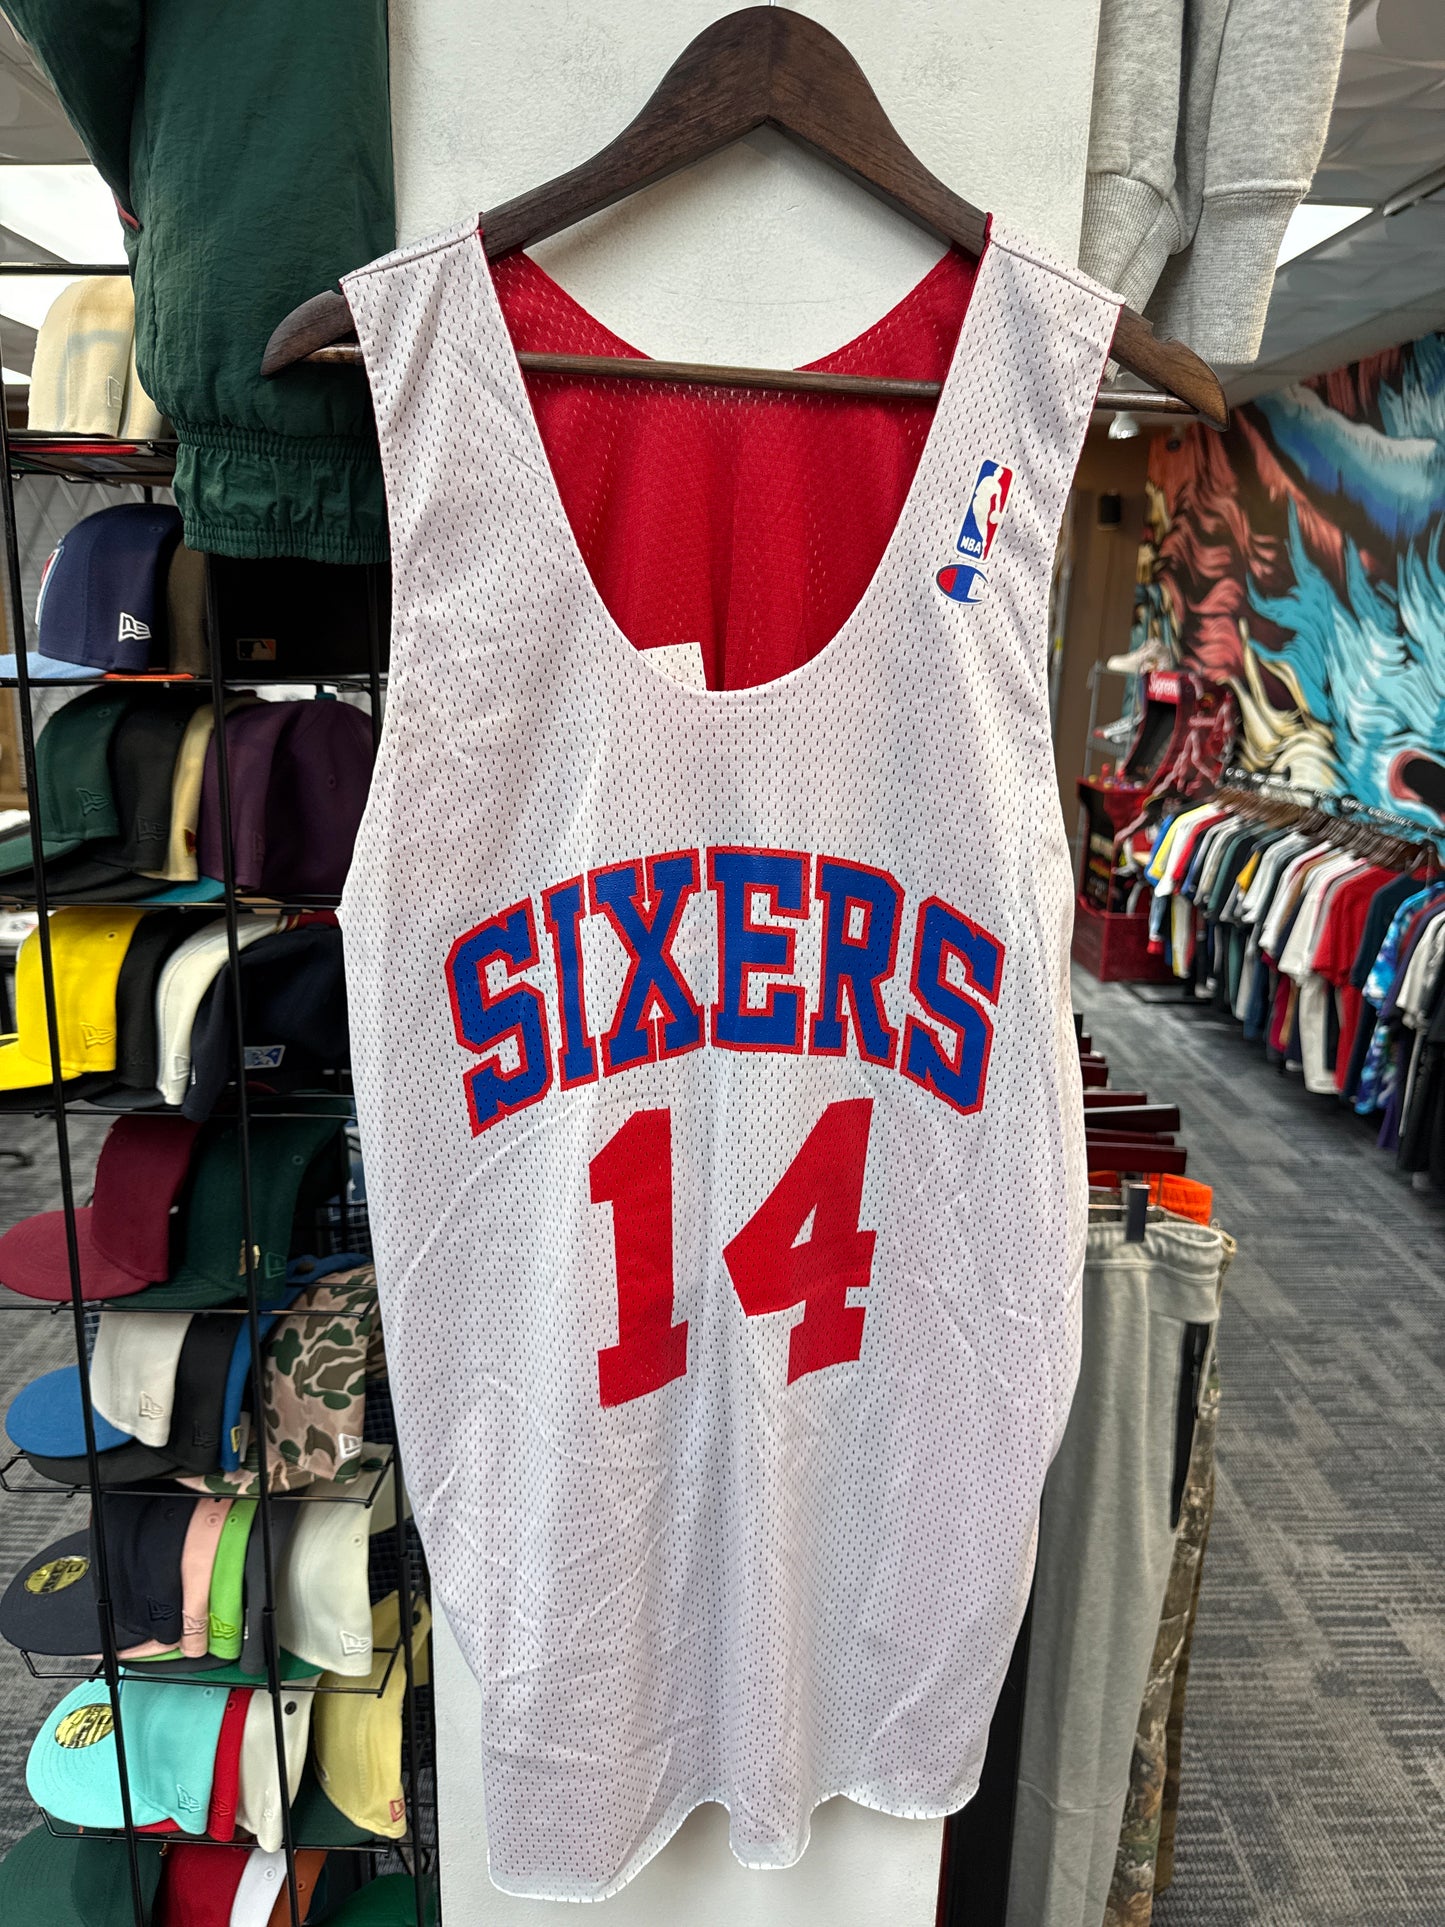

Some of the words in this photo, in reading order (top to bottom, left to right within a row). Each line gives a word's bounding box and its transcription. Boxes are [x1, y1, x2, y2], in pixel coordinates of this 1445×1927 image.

[960, 535, 982, 554] NBA
[444, 845, 1005, 1137] SIXERS
[589, 1098, 876, 1408] 14
